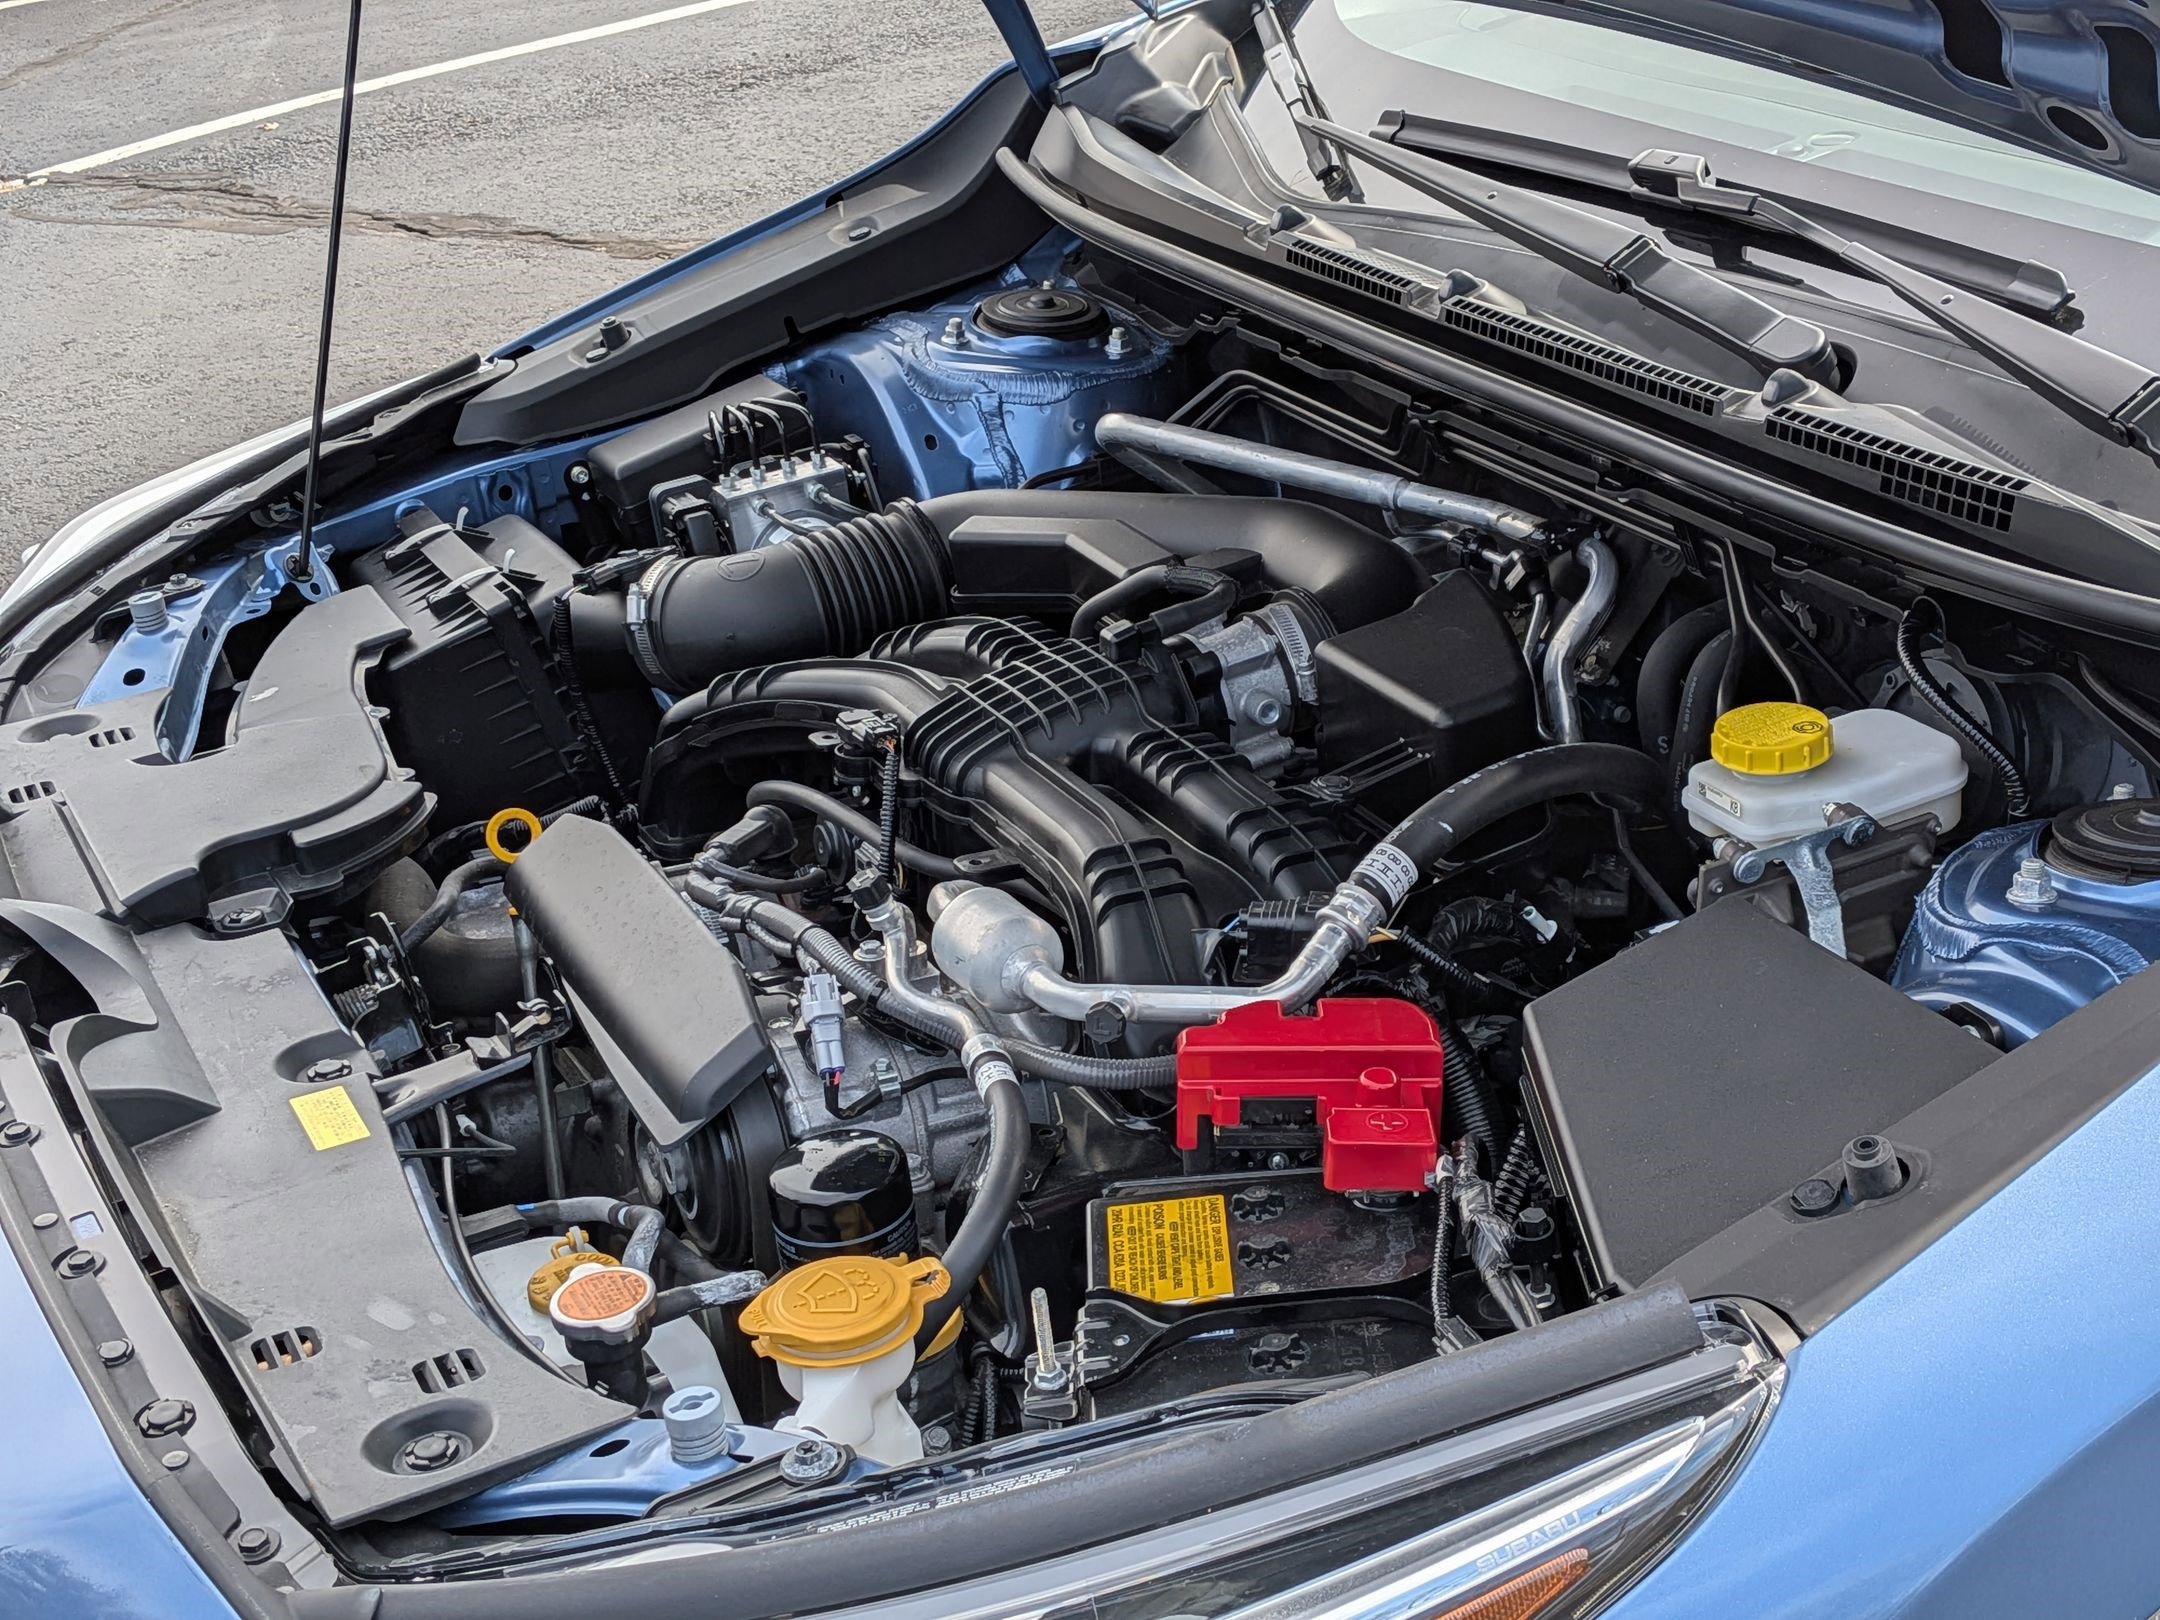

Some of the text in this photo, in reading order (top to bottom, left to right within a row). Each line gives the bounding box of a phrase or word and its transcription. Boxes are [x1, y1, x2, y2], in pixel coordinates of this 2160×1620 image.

[1152, 1203, 1164, 1229] POISON
[1208, 1197, 1221, 1225] DANGER
[1475, 1510, 1580, 1572] SUBARU
